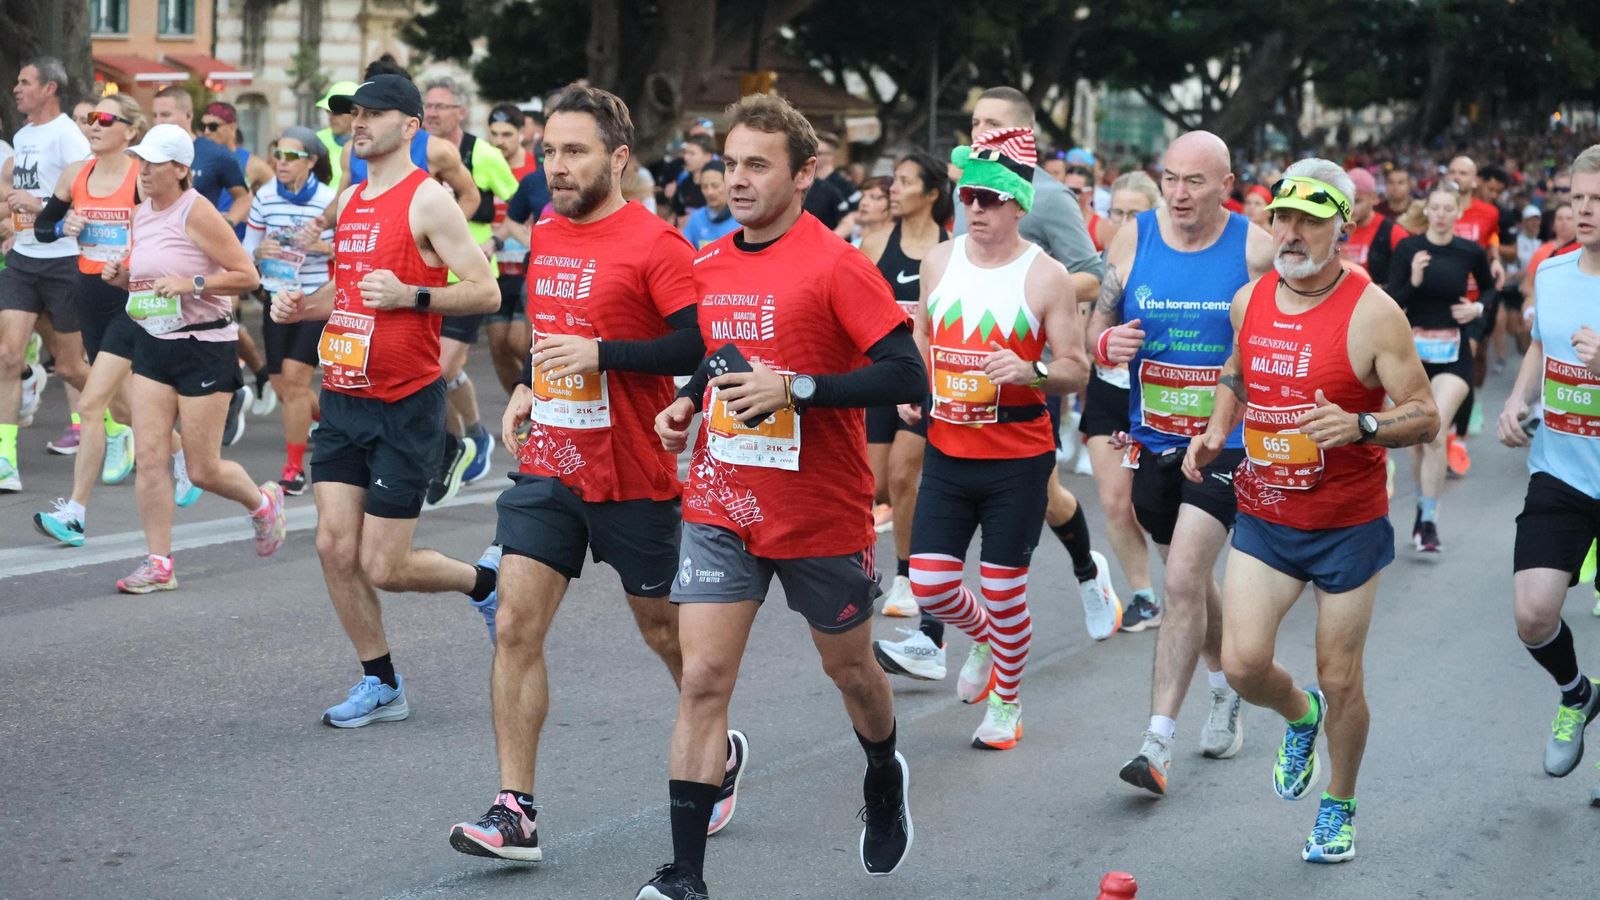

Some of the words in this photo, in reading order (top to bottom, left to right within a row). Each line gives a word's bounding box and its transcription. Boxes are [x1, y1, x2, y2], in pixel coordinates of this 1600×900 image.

[88, 211, 126, 220] GENERALI
[87, 227, 118, 239] 15905
[338, 238, 366, 253] MÁLAGA
[543, 255, 583, 269] GENERALI
[535, 276, 575, 299] MÁLAGA
[714, 294, 760, 307] GENERALI
[1146, 299, 1165, 310] the
[1166, 299, 1201, 310] koram
[1202, 301, 1231, 311] centr
[733, 311, 757, 321] MARATÓN
[711, 317, 759, 341] MÁLAGA
[1168, 328, 1201, 338] Your
[328, 338, 352, 354] 2418
[1169, 341, 1226, 352] Matters
[1257, 336, 1299, 352] GENERALI
[946, 352, 985, 366] GENERA
[1251, 356, 1294, 377] MÁLAGA
[1161, 367, 1217, 382] GENERALI
[945, 375, 978, 392] 1663
[1161, 390, 1199, 407] 2532
[1557, 387, 1592, 405] 6768
[1263, 436, 1290, 453] 665
[695, 569, 725, 578] Emirates
[904, 646, 938, 657] BROOKS
